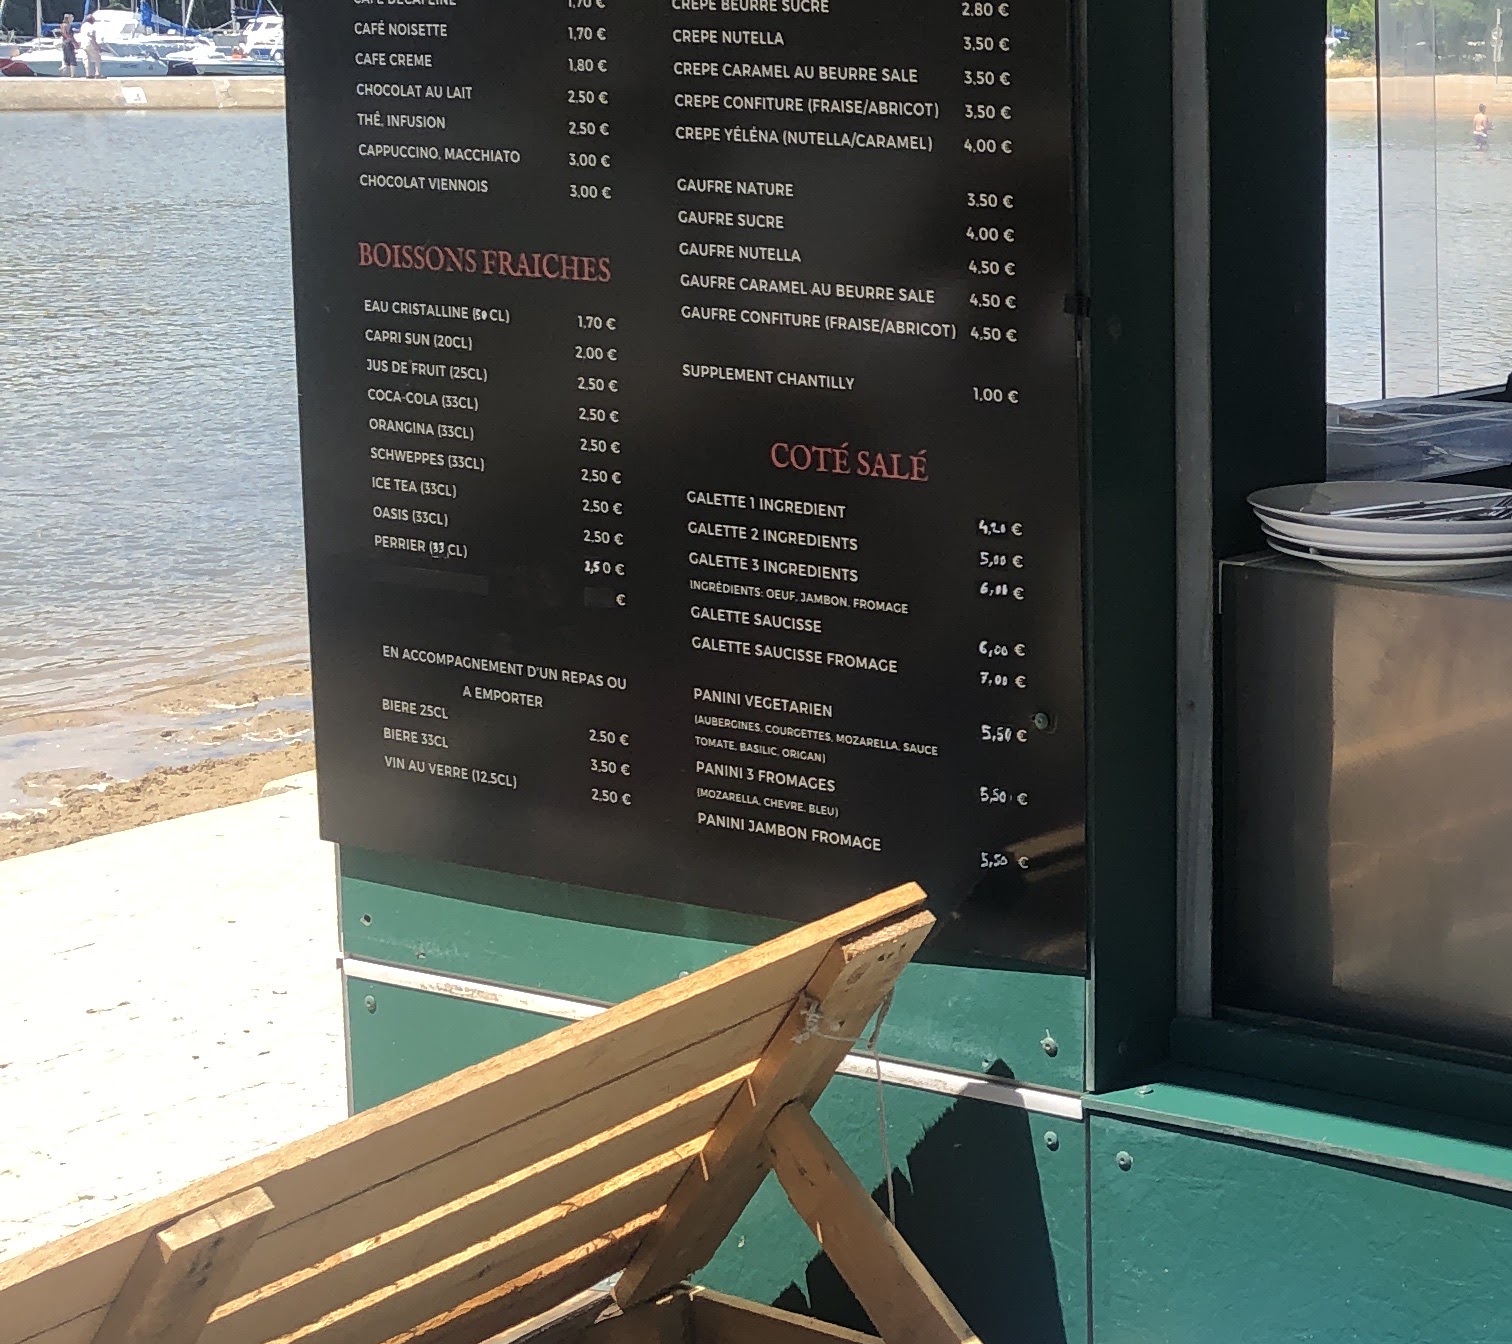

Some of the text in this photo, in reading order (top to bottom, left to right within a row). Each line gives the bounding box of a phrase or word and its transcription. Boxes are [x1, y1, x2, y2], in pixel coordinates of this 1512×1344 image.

[354, 20, 447, 36] CAFÉ NOISETTE
[673, 29, 784, 45] CREPE NUTELLA
[355, 53, 432, 67] CAFE CREME
[674, 62, 918, 83] CREPE CARAMEL AU BEURRE SALE
[356, 83, 472, 99] CHOCOLAT AU LAIT
[675, 94, 939, 119] CREPE CONFITURE (FRAISE/ABRICOT)
[387, 115, 445, 129] INFUSION
[675, 126, 720, 141] CREPE
[783, 130, 932, 152] (NUTELLA/CARAMEL)
[445, 148, 520, 163] MACCHIATO
[360, 174, 488, 192] CHOCOLAT VIENNOIS
[677, 178, 794, 197] GAUFRE NATURE
[678, 210, 734, 226] GAUFRE
[738, 214, 784, 229] SUCRE
[1003, 229, 1014, 242] €
[358, 242, 611, 282] BOISSONS FRAICHES
[364, 300, 469, 319] EAU CRISTALLINE
[365, 329, 472, 351] CAPRI SUN (20CL)
[367, 359, 487, 382] JUS DE FRUIT (25CL)
[682, 364, 854, 390] SUPPLEMENT CHANTILLY
[368, 388, 478, 411] COCA-COLA (33CL)
[369, 418, 474, 441] ORANGINA (33CL)
[371, 447, 484, 472] SCHWEPPES (33CL)
[771, 442, 928, 481] COTÉ SALÉ
[372, 477, 456, 498] ICE TEA (33CL)
[687, 491, 746, 508] GALETTE
[759, 498, 846, 518] INGREDIENT
[853, 598, 908, 614] FROMAGE
[692, 636, 897, 673] GALETTE SAUCISSE FROMAGE
[383, 645, 626, 690] EN ACCOMPAGNEMENT D'UN REPAS OU
[463, 686, 543, 707] A EMPORTER
[382, 698, 448, 719] BIERE 25CL
[694, 688, 740, 705] PANINI
[745, 694, 832, 717] VEGETARIEN
[1016, 729, 1027, 742] €
[384, 755, 468, 779] VIN AU VERRE
[696, 761, 835, 792] PANINI 3 FROMAGES
